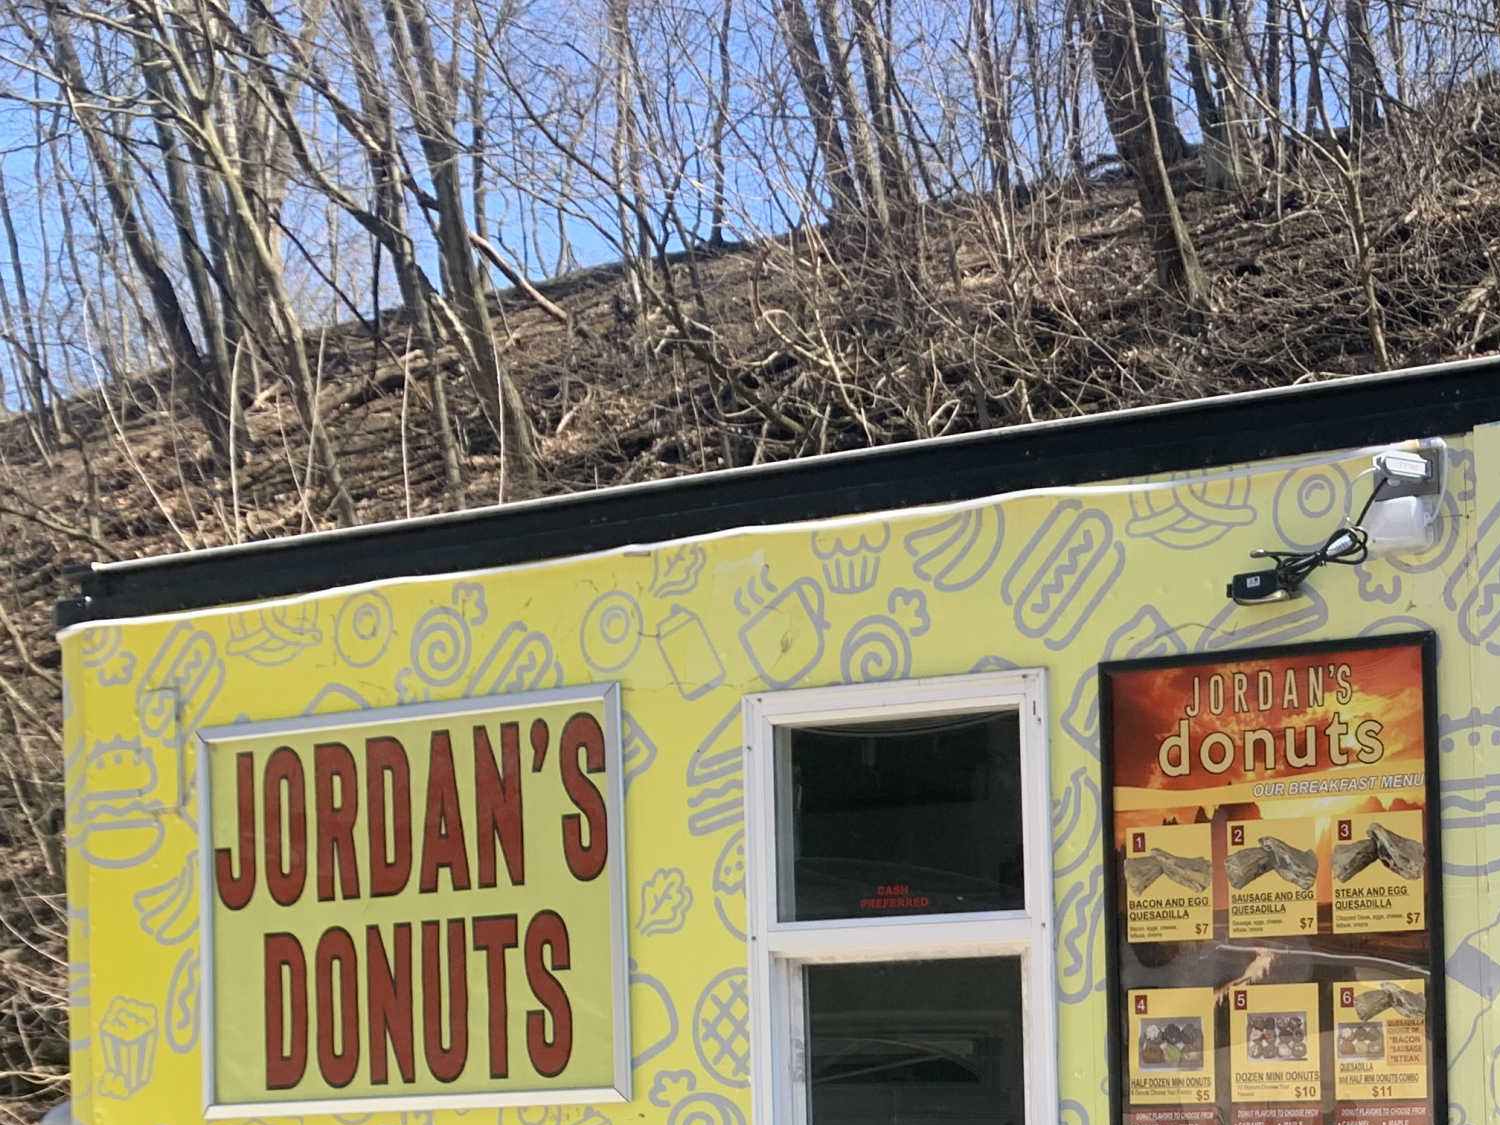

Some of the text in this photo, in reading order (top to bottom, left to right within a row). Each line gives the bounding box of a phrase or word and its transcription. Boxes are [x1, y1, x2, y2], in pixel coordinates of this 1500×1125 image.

[1185, 663, 1353, 718] JORDAN'S
[1158, 711, 1385, 777] donuts
[1253, 773, 1425, 798] OUR BREAKFAST MENU
[214, 711, 609, 911] JORDAN'S
[1234, 829, 1243, 842] 2
[1340, 824, 1349, 837] 3
[877, 885, 909, 895] CASH
[1335, 886, 1408, 898] STEAK AND EGG
[1129, 897, 1209, 910] BACON AND EGG
[1231, 891, 1314, 904] SAUSAGE AND EGG
[1231, 904, 1287, 915] QUESADILLA
[1335, 899, 1392, 910] QUESADILLA
[1129, 910, 1190, 921] QUESADILLA
[1406, 912, 1421, 925] $7
[1195, 923, 1209, 935] $7
[1300, 917, 1314, 930] $7
[263, 909, 574, 1091] DONUTS
[1237, 994, 1246, 1007] 5
[1342, 991, 1352, 1004] 6
[1235, 1071, 1321, 1081] DOZEN MINI DONUTS
[1196, 1090, 1210, 1101] $5
[1294, 1086, 1317, 1098] $10
[1372, 1086, 1393, 1097] $11
